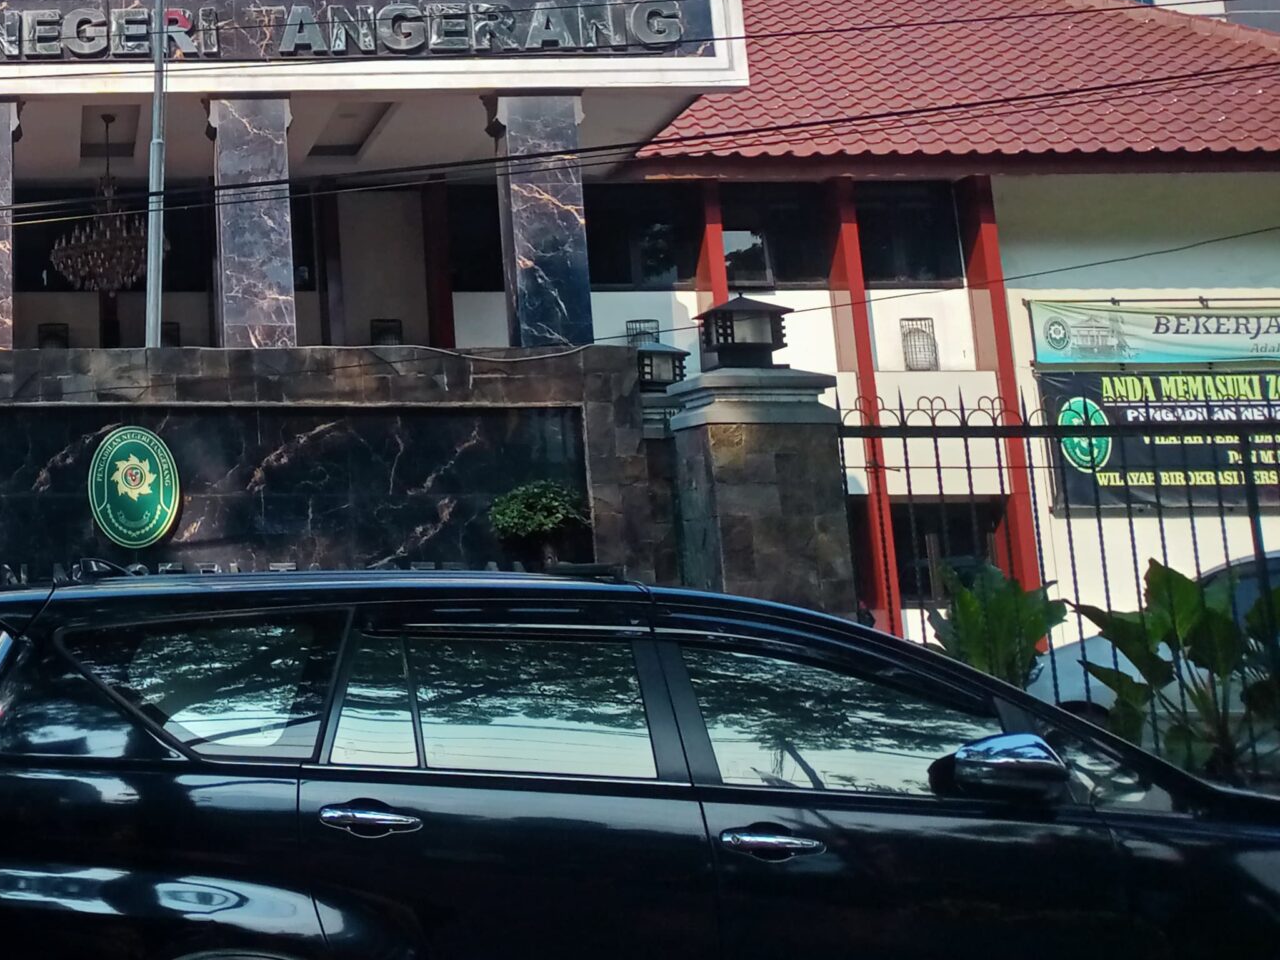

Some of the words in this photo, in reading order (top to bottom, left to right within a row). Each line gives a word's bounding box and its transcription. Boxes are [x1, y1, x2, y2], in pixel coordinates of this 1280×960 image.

[1102, 376, 1156, 401] ANDA
[1159, 375, 1263, 401] MEMASUKI
[97, 437, 122, 482] PENGADILAN
[122, 431, 151, 444] NEGERI
